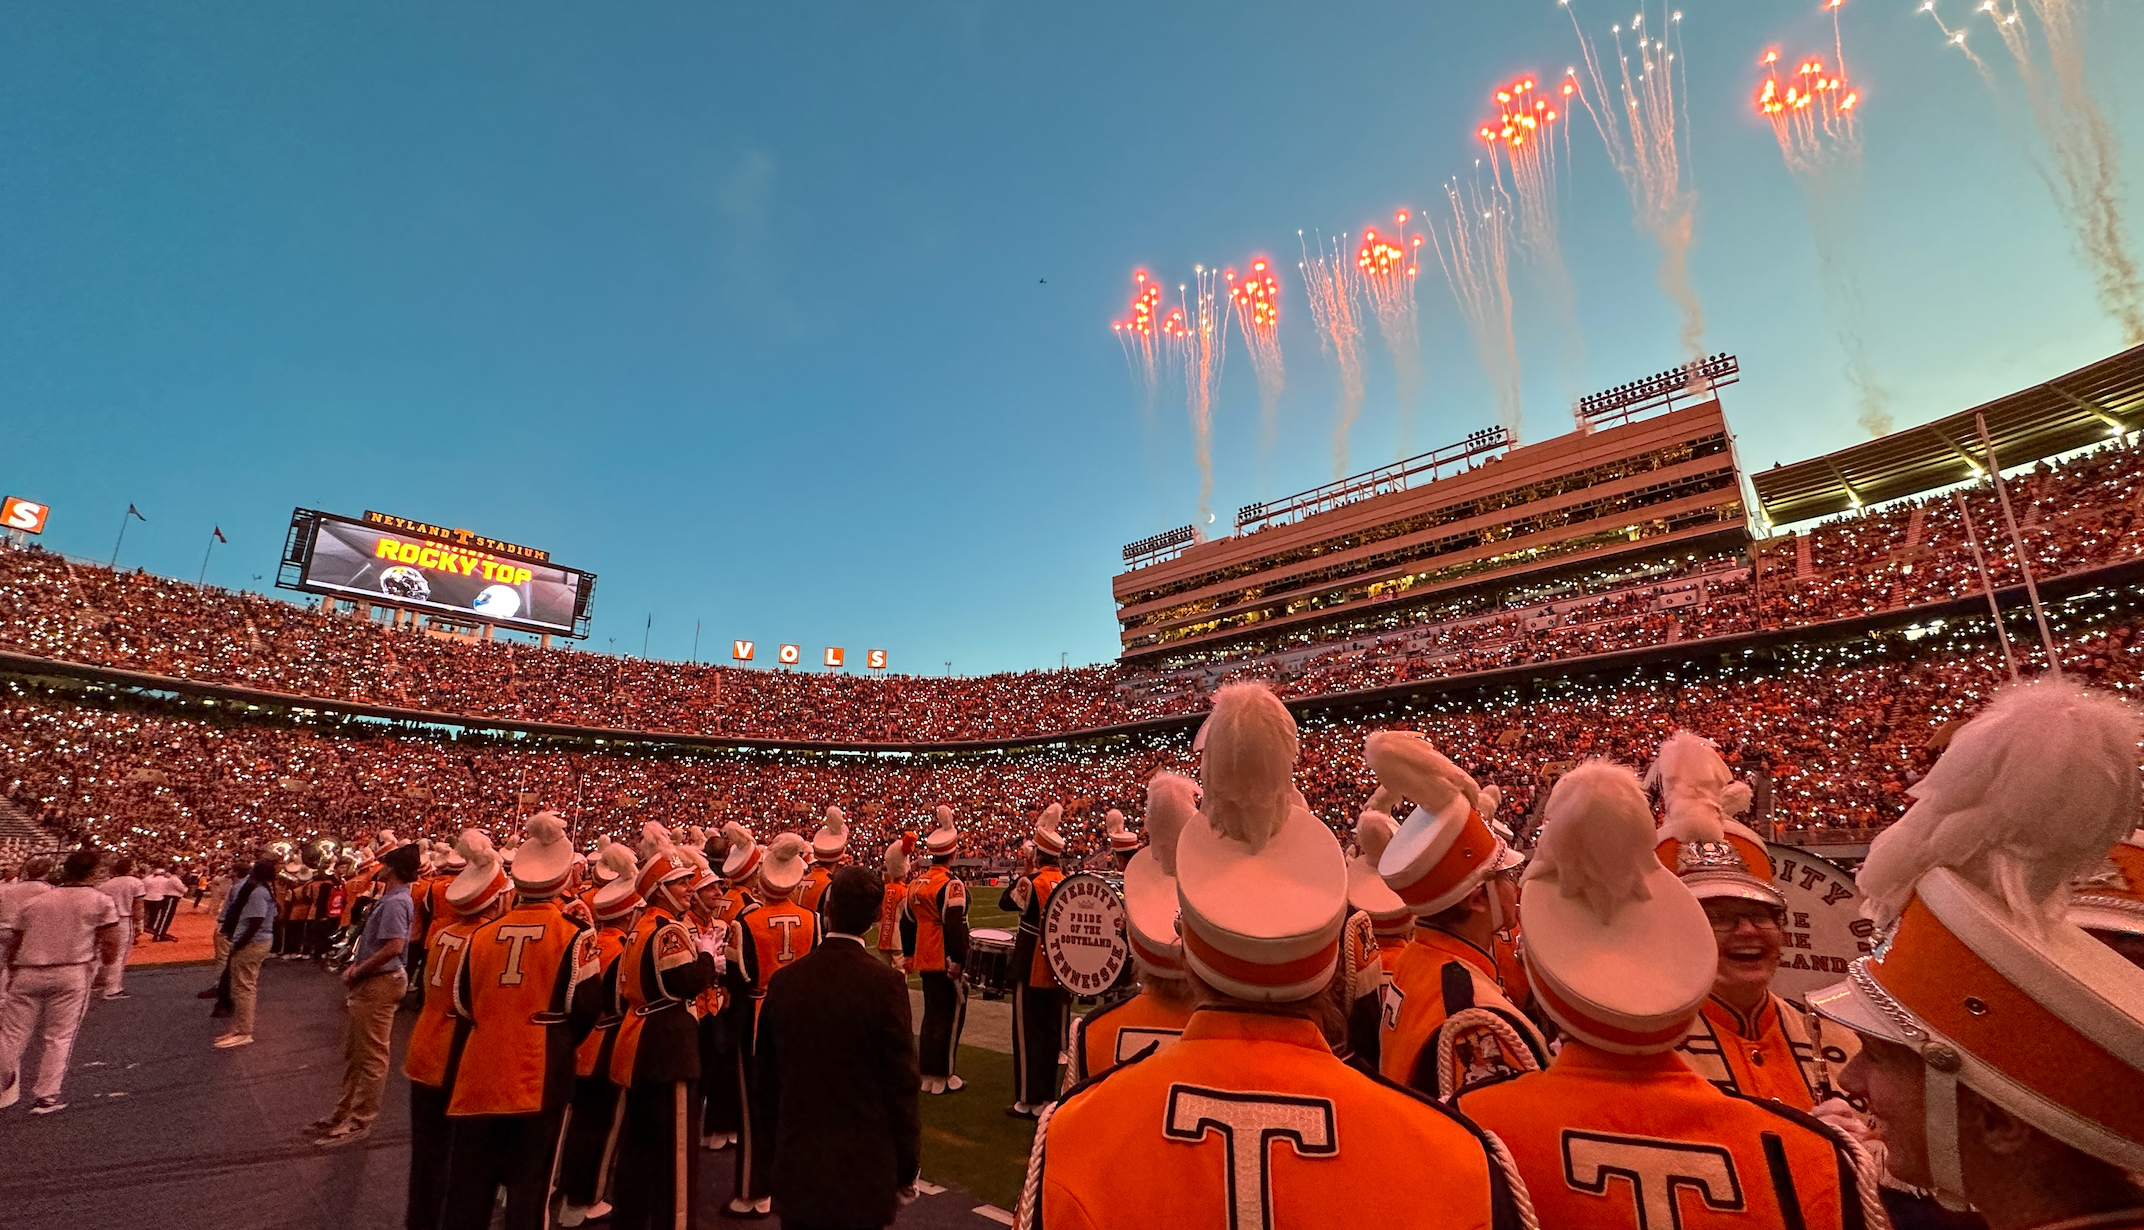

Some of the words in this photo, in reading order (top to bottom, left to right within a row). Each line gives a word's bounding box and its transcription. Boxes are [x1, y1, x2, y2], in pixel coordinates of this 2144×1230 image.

[8, 502, 40, 529] S
[370, 512, 450, 539] NEYLAND
[454, 528, 475, 545] T
[476, 537, 546, 560] STADIUM
[375, 538, 479, 576] ROCKY
[481, 559, 532, 585] TOP
[1049, 882, 1117, 934] UNIVERSITY
[1070, 912, 1102, 924] PRIDE
[1070, 924, 1081, 934] OF
[1084, 925, 1101, 935] THE
[430, 931, 467, 988] T
[496, 924, 546, 986] T
[767, 915, 801, 962] T
[1061, 935, 1112, 948] SOUTHLAND
[1050, 938, 1124, 989] TENNESSEE
[1163, 1082, 1340, 1230] T
[1561, 1127, 1748, 1230] T
